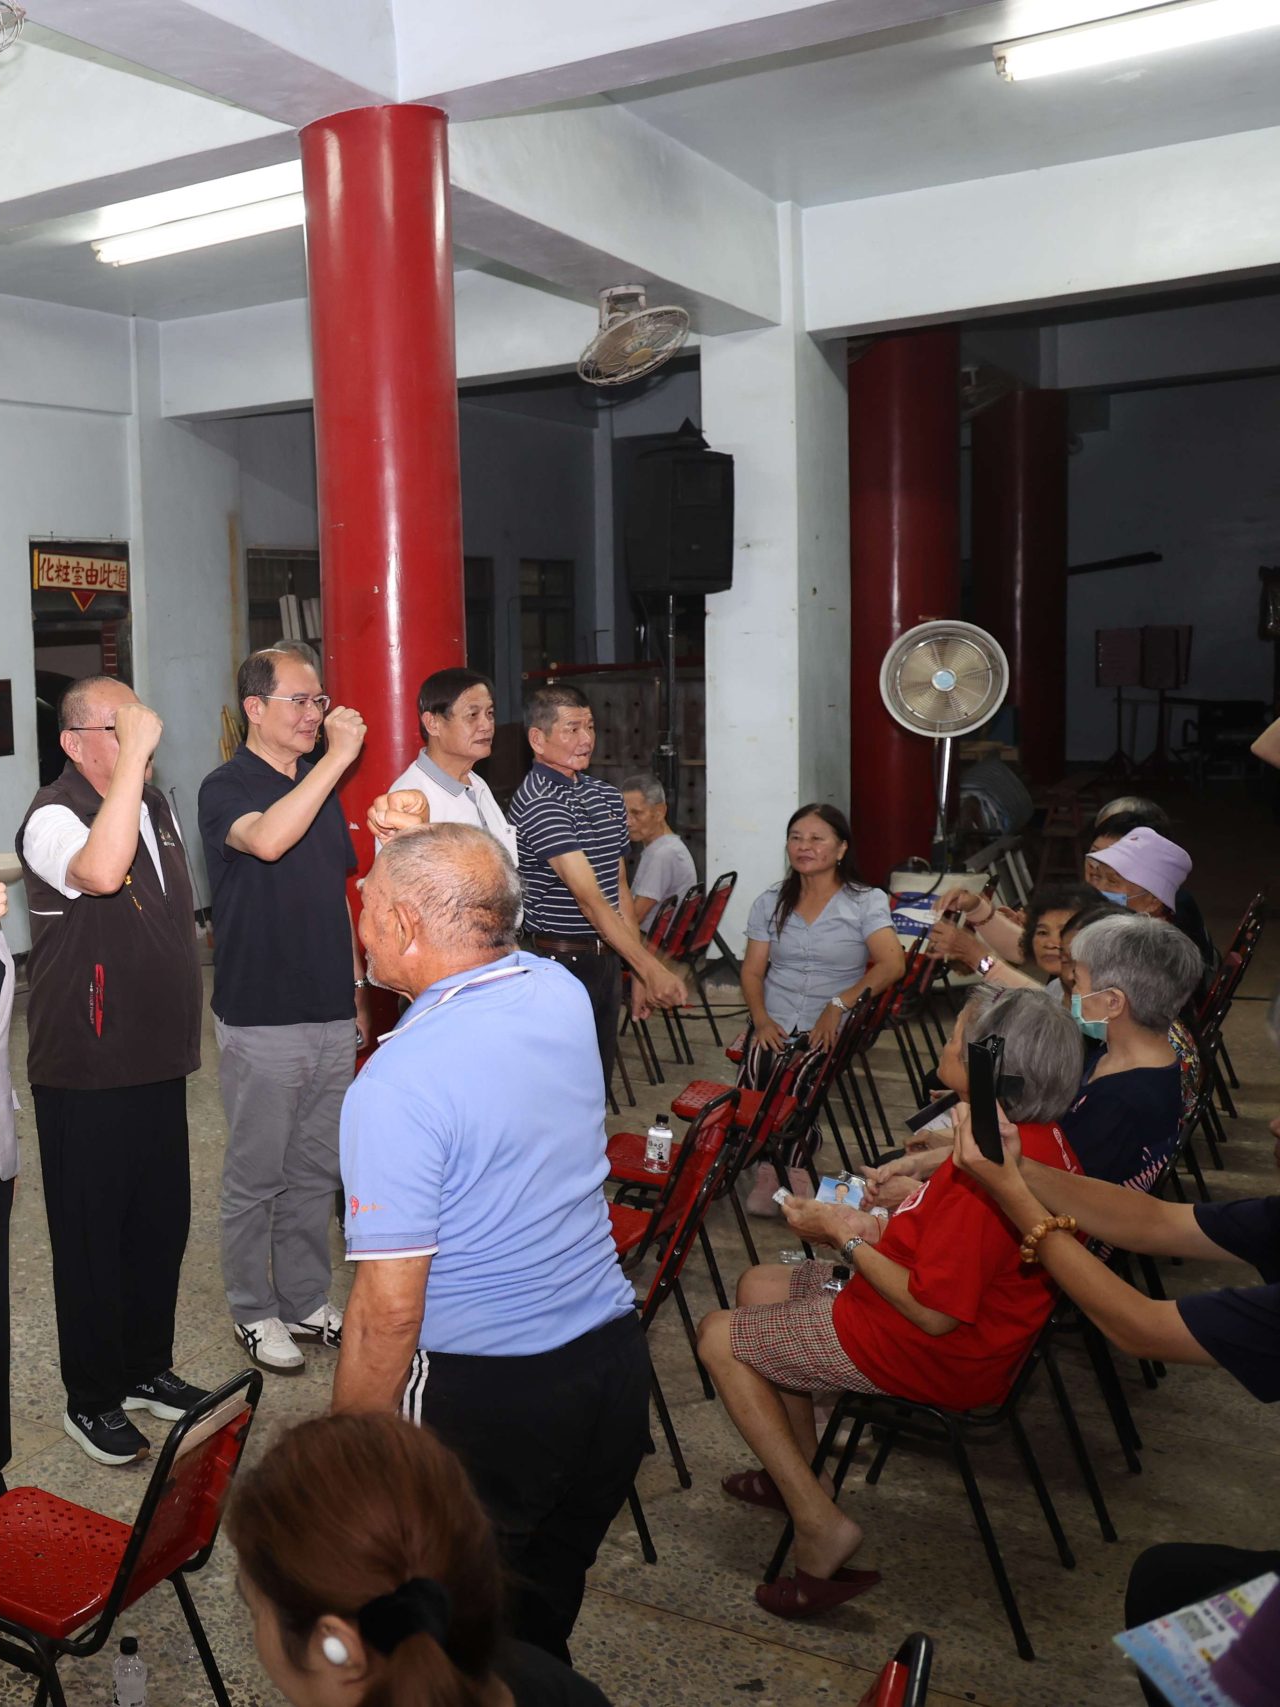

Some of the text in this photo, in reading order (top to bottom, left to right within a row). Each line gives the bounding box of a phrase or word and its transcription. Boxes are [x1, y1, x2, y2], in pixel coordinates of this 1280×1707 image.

[40, 557, 126, 588] 化粧室由此進
[77, 1413, 94, 1431] FILA
